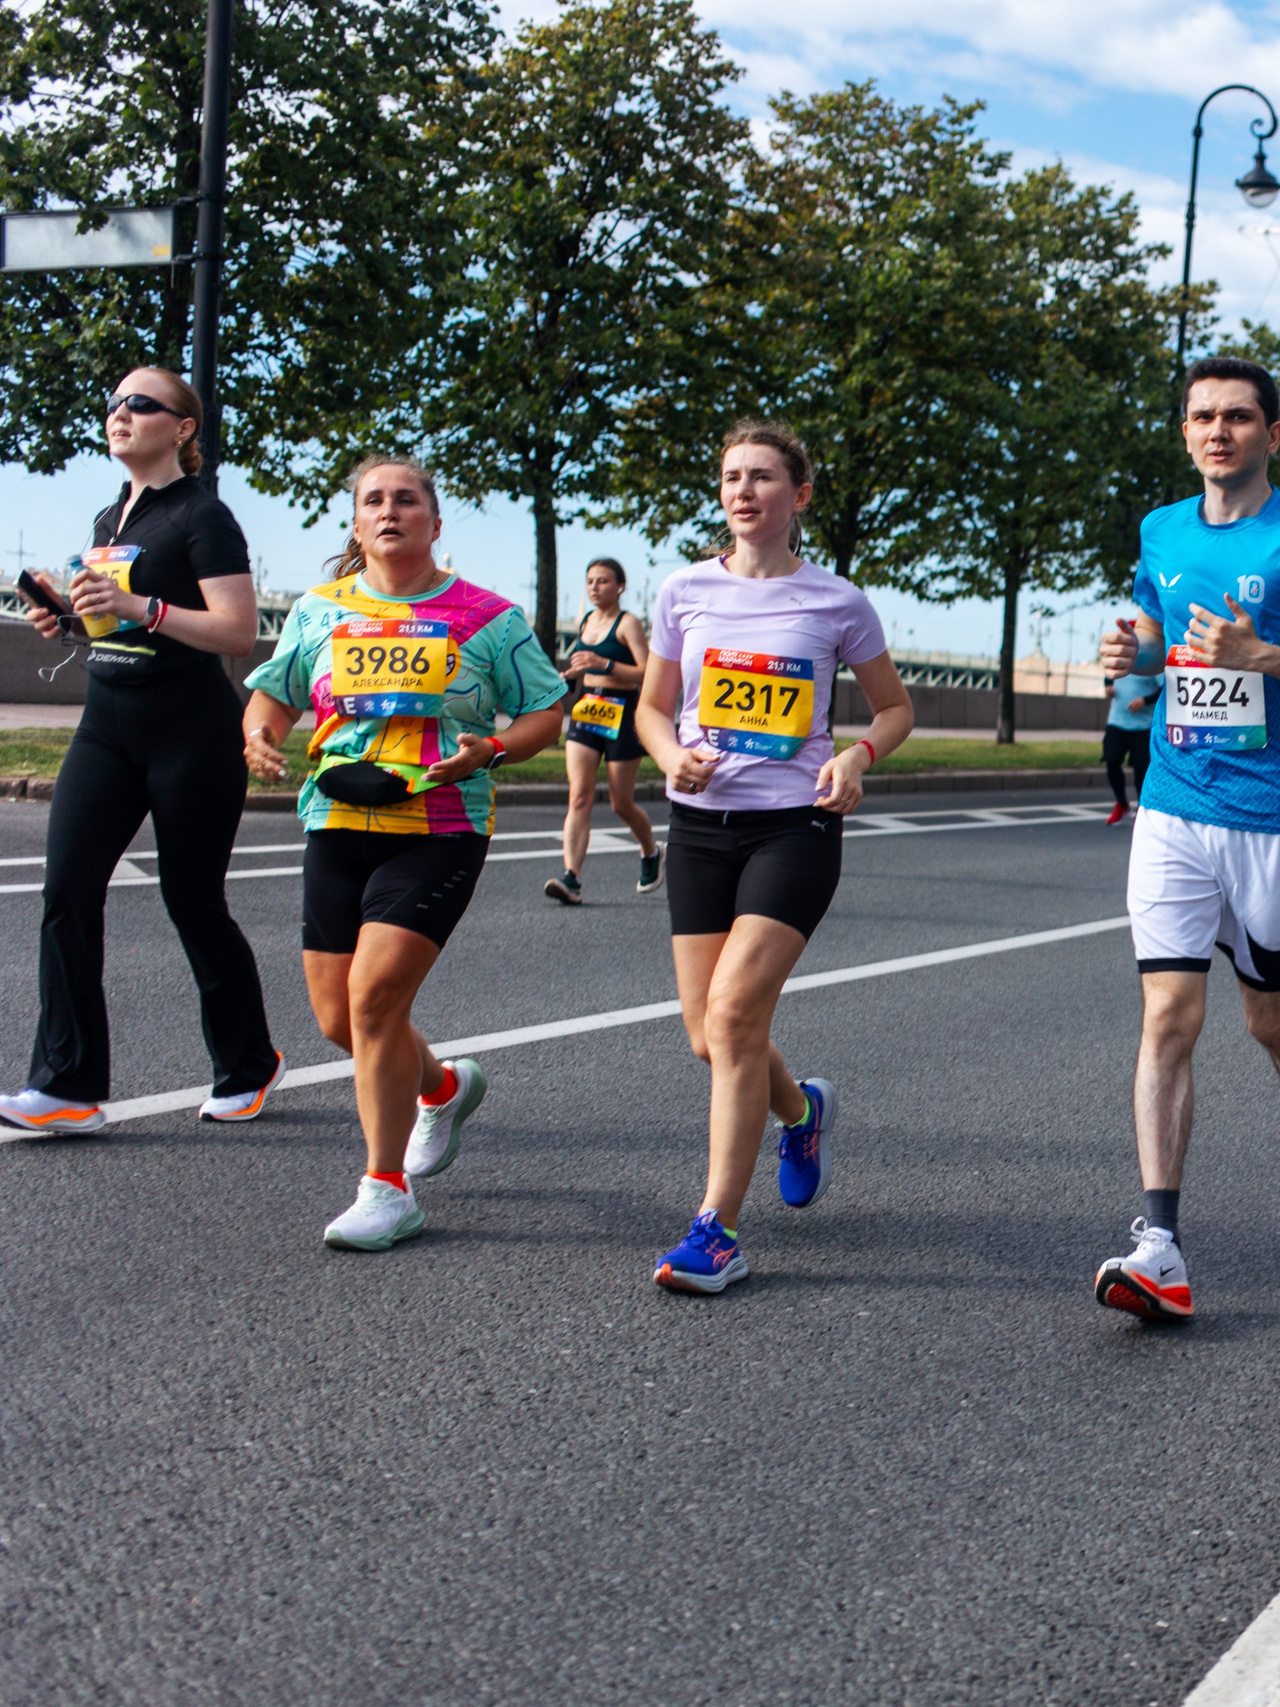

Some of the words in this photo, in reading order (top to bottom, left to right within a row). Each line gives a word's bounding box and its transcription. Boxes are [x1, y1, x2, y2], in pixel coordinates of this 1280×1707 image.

[398, 624, 416, 634] 21,1
[95, 653, 139, 664] DEMIX
[346, 646, 430, 675] 3986
[767, 660, 784, 672] 21,1
[351, 677, 424, 688] АЛЕКСАНДРА
[1176, 676, 1250, 707] 5224
[343, 696, 357, 714] E
[714, 678, 800, 717] 2317
[580, 702, 617, 720] 3665
[1191, 710, 1228, 721] МАМЕД
[739, 715, 769, 727] АННА
[707, 728, 720, 747] E
[1172, 726, 1184, 745] D
